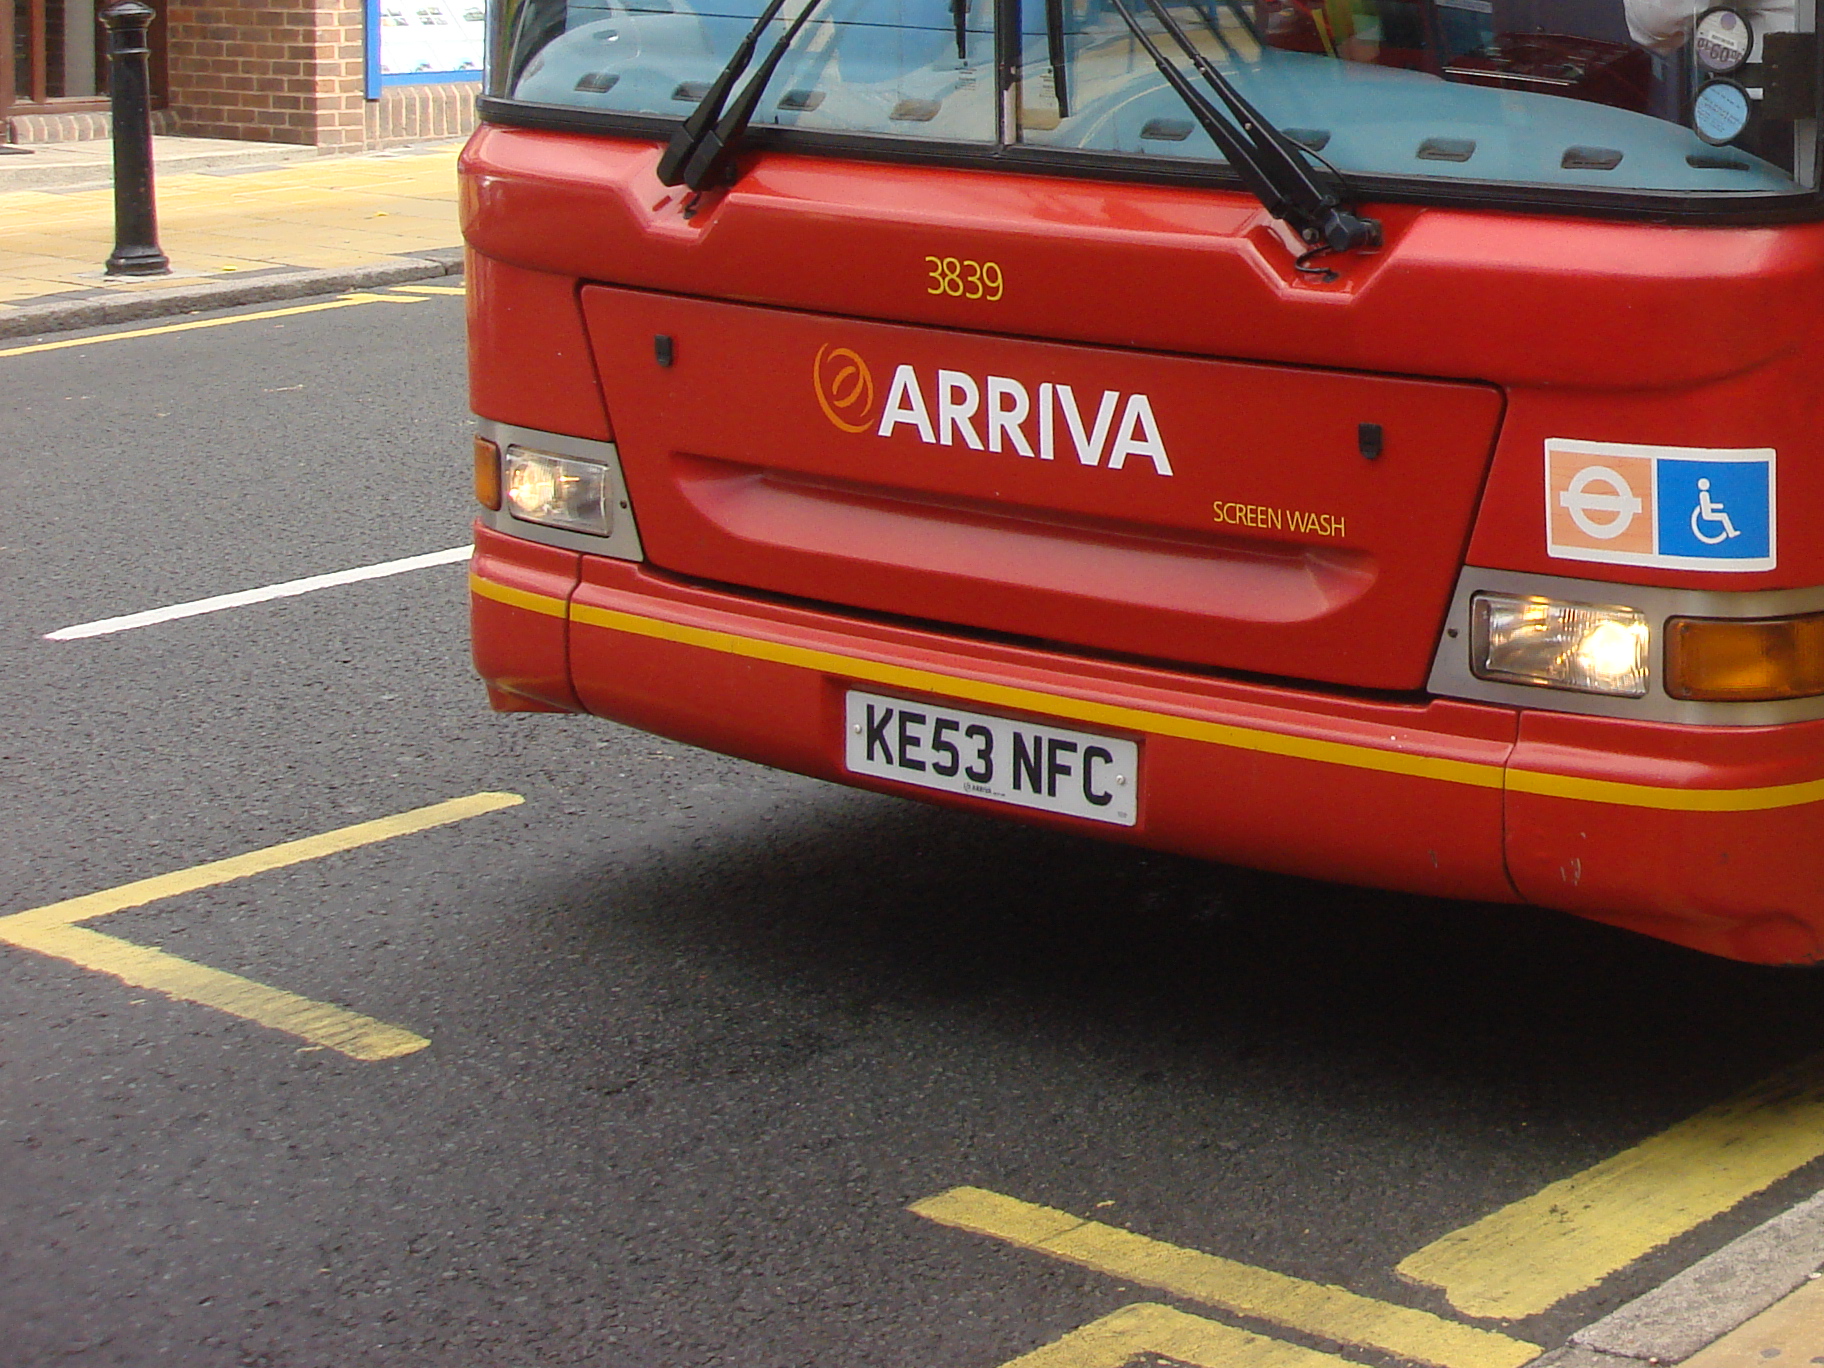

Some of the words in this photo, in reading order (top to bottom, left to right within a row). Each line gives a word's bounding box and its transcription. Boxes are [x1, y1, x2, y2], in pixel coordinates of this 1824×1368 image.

[925, 256, 1003, 301] 3839
[878, 364, 1173, 476] ARRIVA
[1213, 501, 1282, 529] SCREEN
[1285, 508, 1346, 537] WASH
[866, 703, 994, 784] KE53
[1012, 731, 1113, 806] NFC
